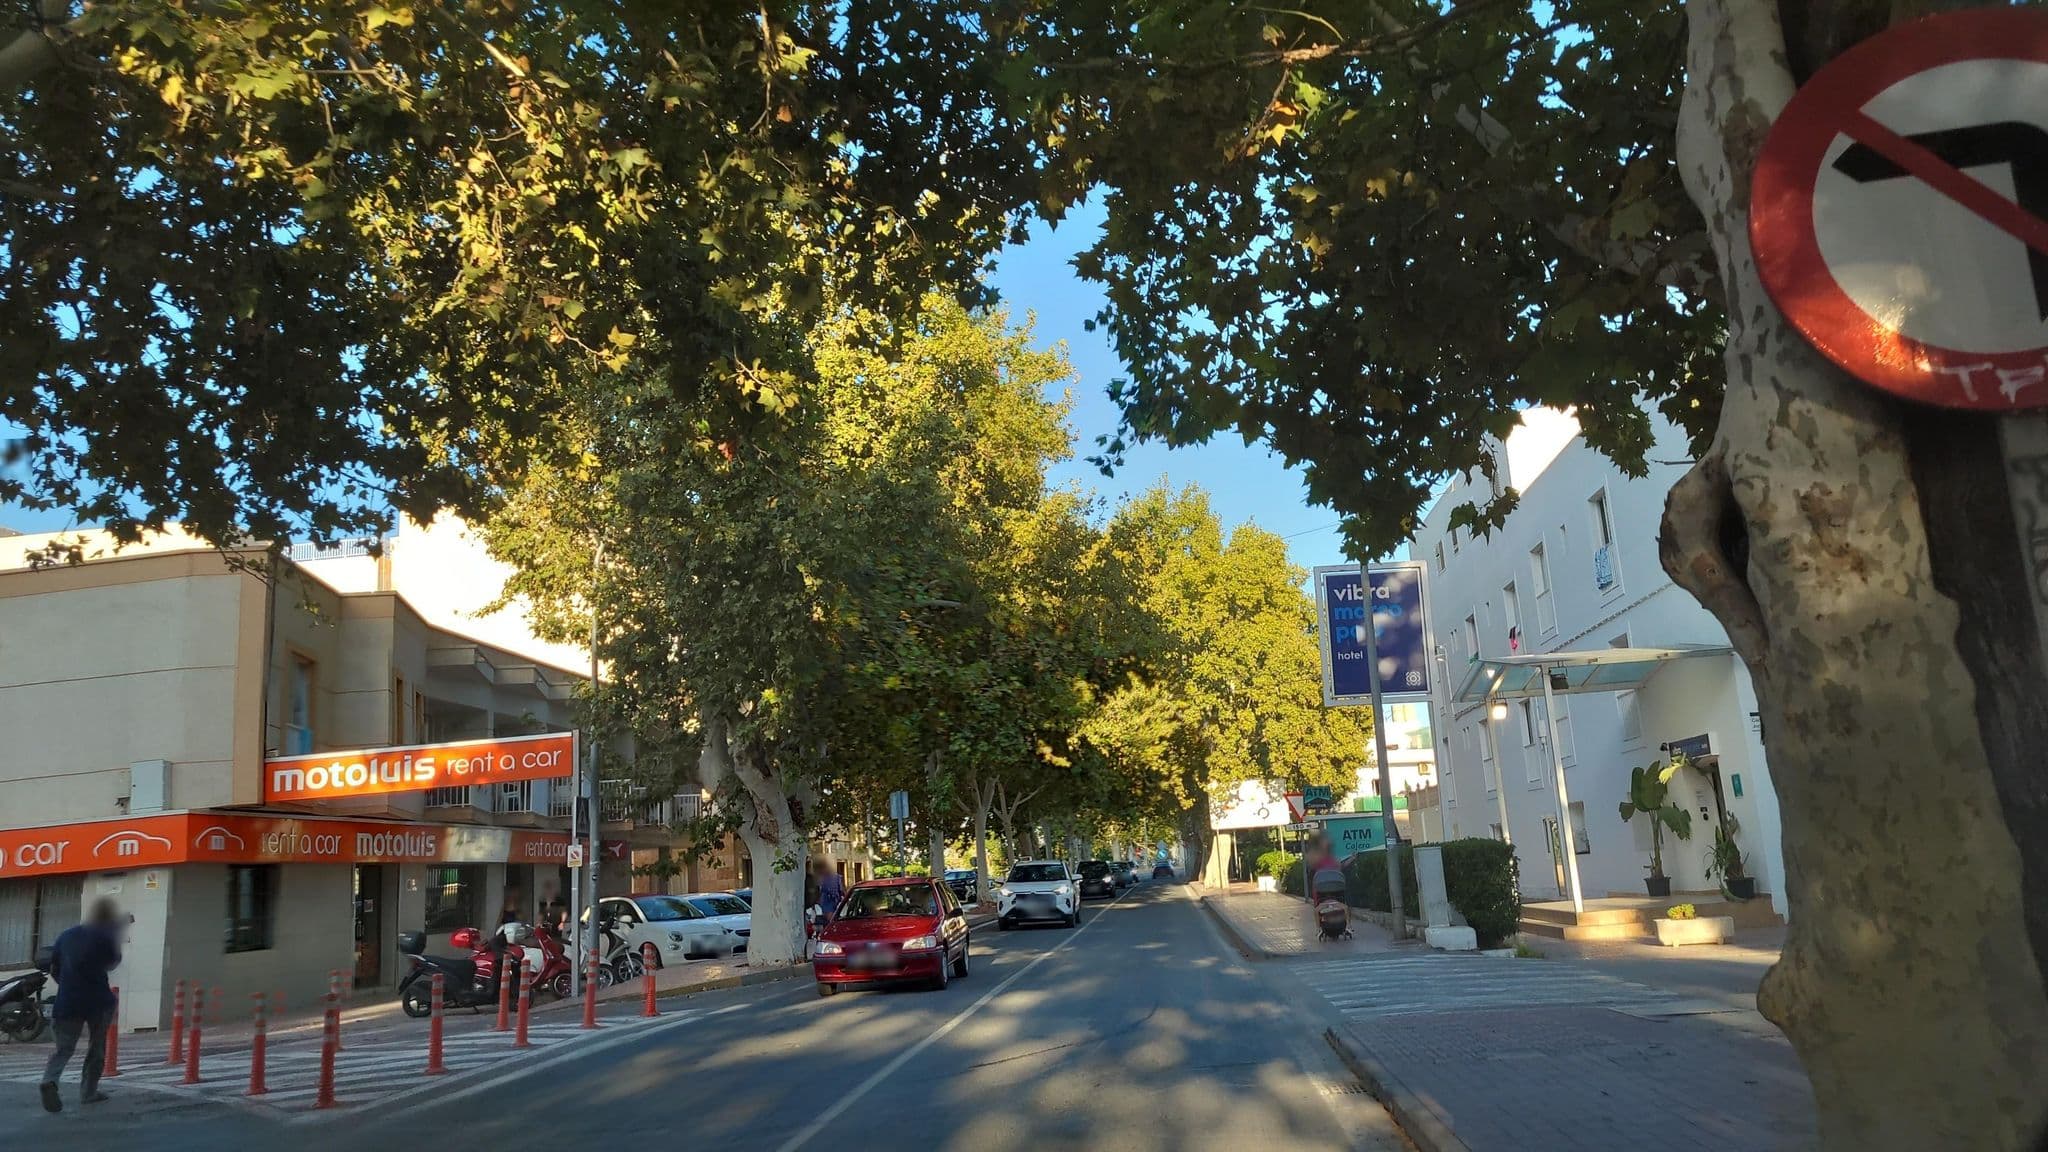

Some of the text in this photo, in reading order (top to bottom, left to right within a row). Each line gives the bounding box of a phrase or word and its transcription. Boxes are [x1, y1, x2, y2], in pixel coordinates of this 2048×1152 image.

[1333, 583, 1390, 601] vibra
[1337, 651, 1364, 661] hotel
[273, 750, 562, 793] motoluis rent a car
[262, 827, 437, 857] rent a car motoluis
[1342, 828, 1372, 841] ATM
[15, 841, 70, 867] car
[525, 838, 543, 857] rent
[544, 843, 552, 857] a
